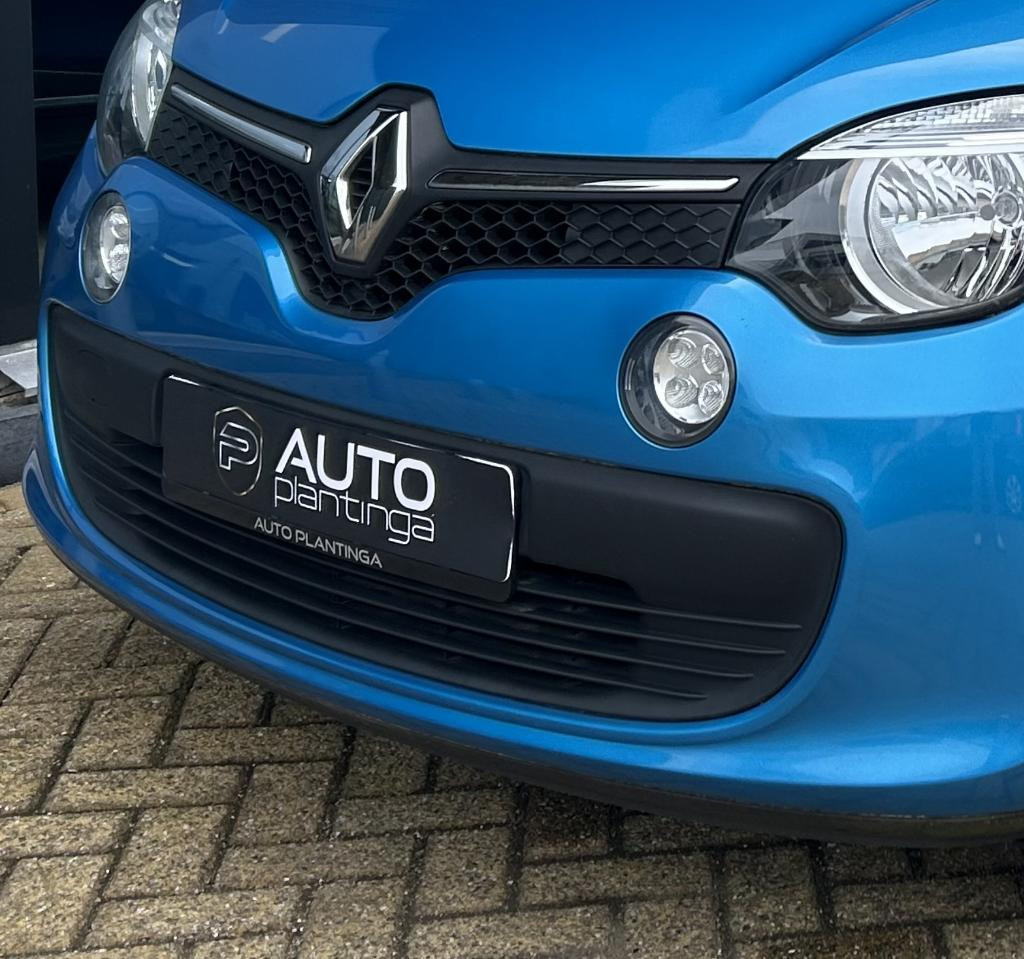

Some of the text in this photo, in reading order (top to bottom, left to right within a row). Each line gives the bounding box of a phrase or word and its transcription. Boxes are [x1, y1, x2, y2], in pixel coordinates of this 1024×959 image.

[275, 427, 436, 512] AUTO
[254, 516, 383, 568] AUTO PLANTINGA
[274, 475, 435, 545] plantinga
